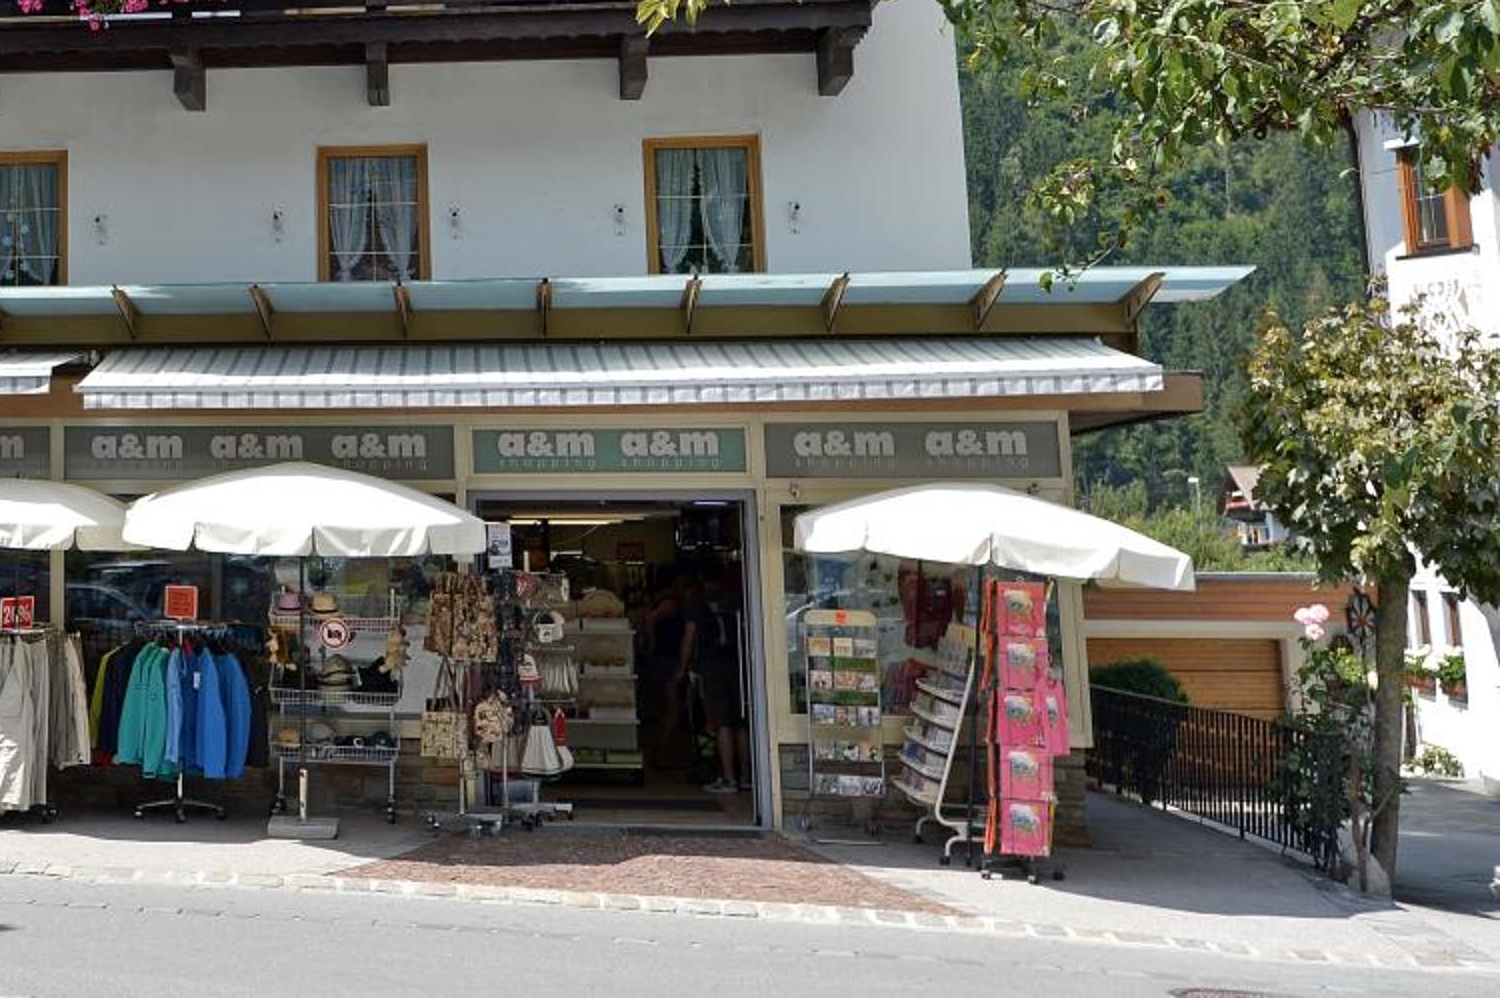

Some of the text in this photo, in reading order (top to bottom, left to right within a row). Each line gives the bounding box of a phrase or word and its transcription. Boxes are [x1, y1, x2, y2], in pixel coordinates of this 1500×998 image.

[91, 433, 427, 459] a&m a&m a&m
[498, 430, 719, 457] a&m a&m
[793, 429, 1028, 457] a&m a&m
[343, 459, 427, 471] hopping
